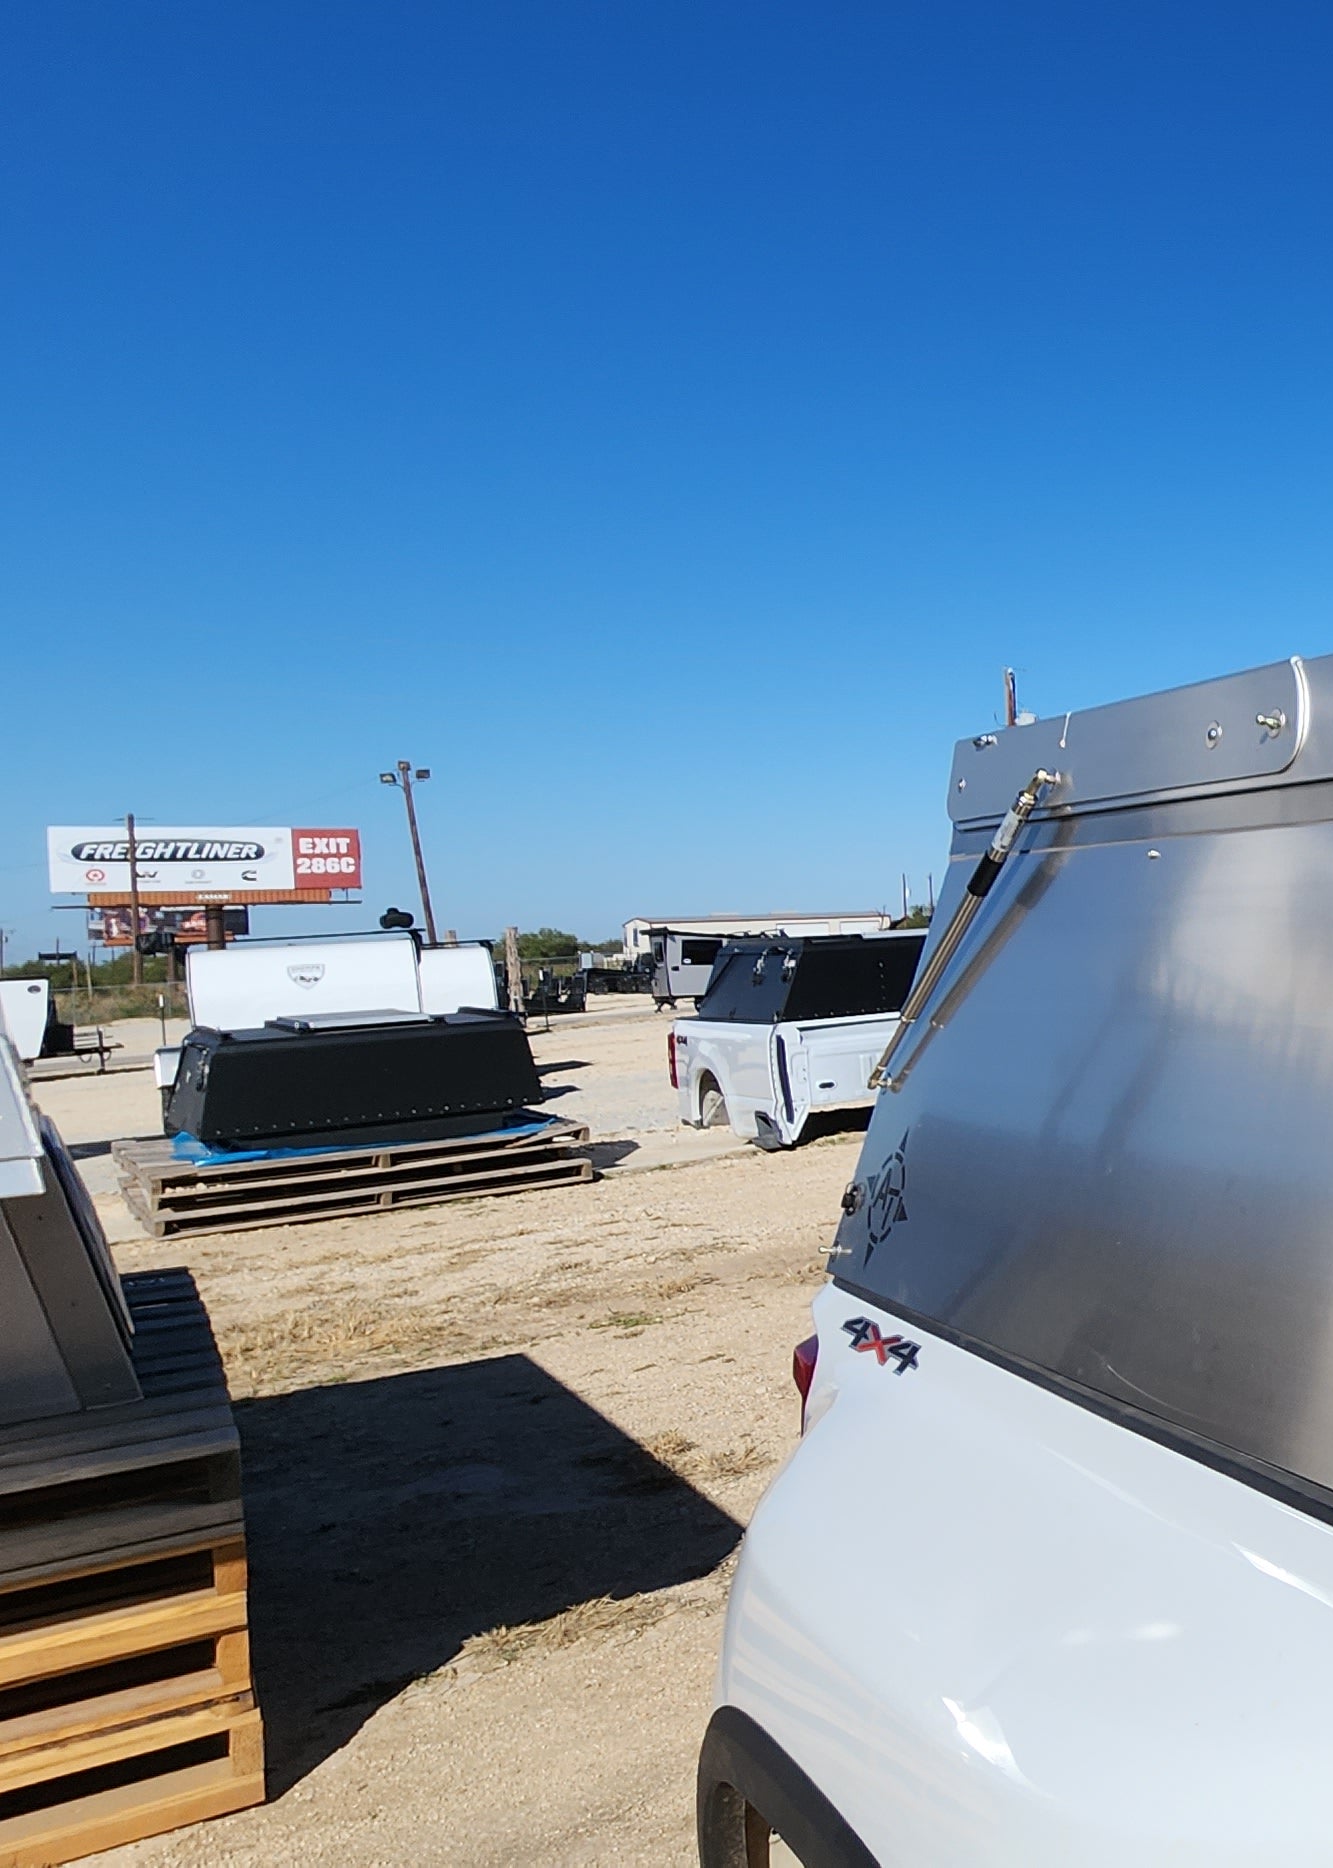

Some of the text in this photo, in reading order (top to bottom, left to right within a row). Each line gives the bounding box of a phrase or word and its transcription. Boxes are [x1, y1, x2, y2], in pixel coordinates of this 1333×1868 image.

[80, 842, 257, 859] FREGHTLINER
[298, 837, 350, 854] EXIT
[296, 857, 356, 875] 286C
